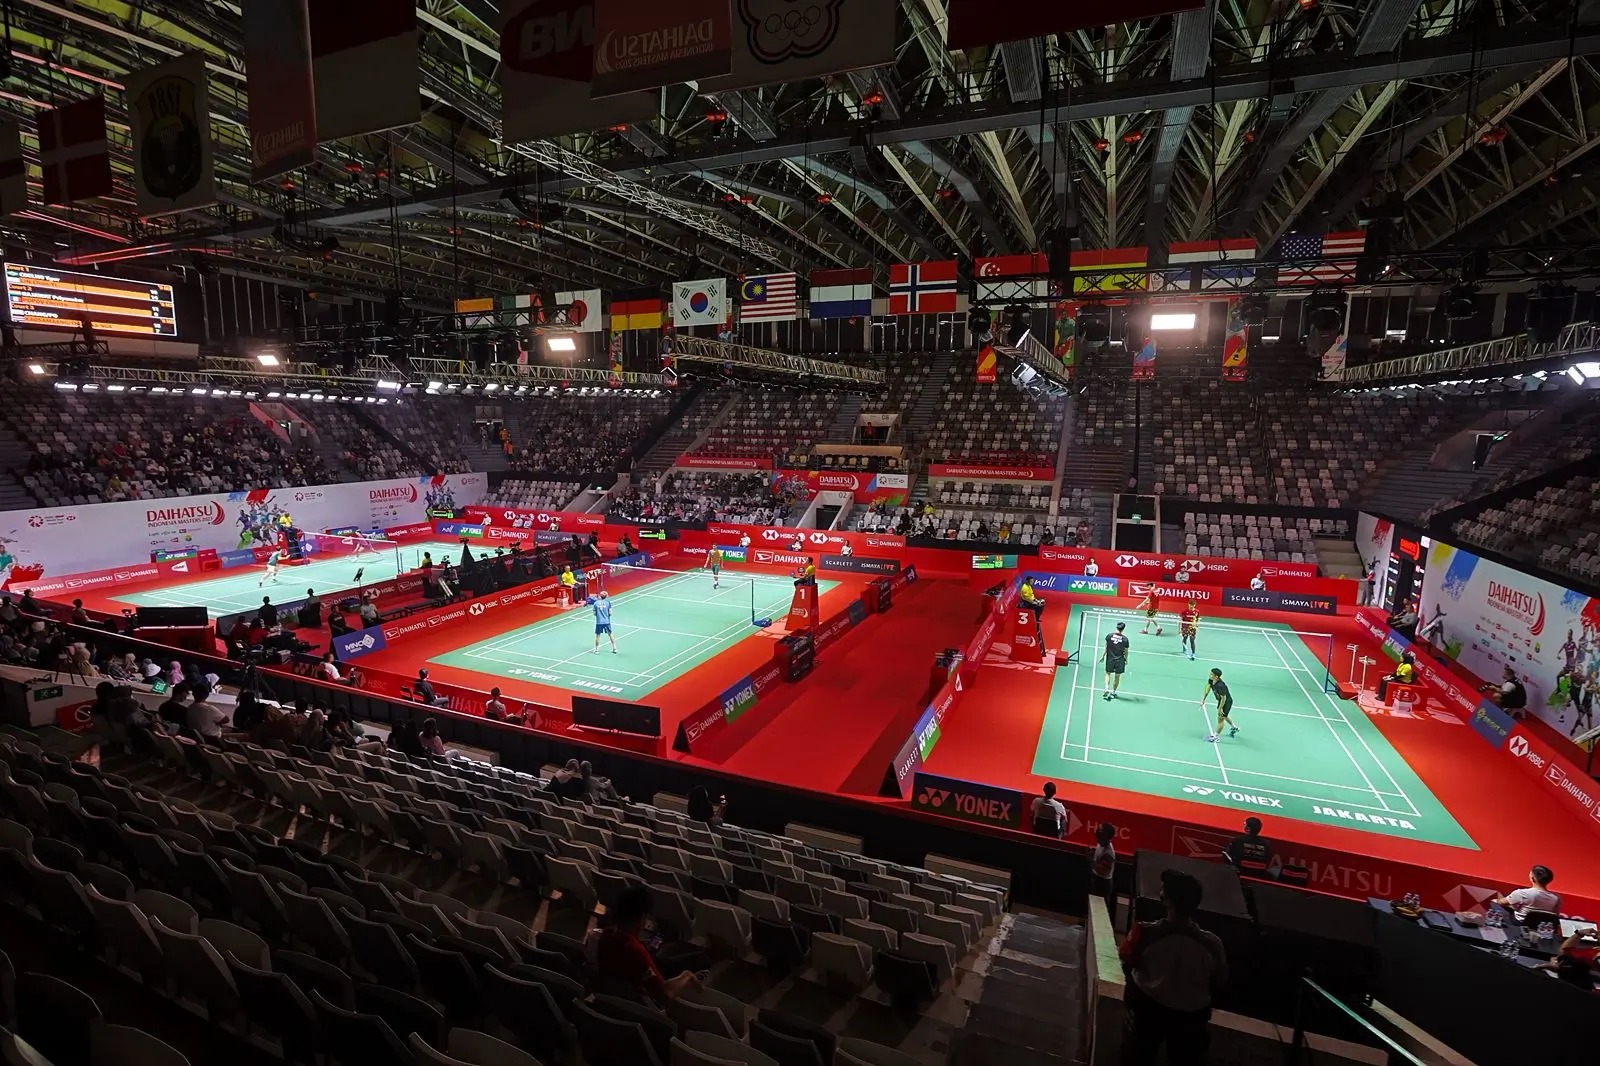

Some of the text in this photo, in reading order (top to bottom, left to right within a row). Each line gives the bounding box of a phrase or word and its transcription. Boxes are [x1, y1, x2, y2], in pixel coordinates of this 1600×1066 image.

[819, 475, 853, 484] DAIHATSU
[369, 487, 410, 500] DAIHATSU
[146, 505, 213, 522] DAIHATSU
[279, 534, 283, 542] 2
[502, 530, 530, 539] DAIHATSU
[725, 550, 745, 558] YONEX
[1057, 553, 1085, 561] DAIHATSU
[774, 555, 808, 565] DAIHATS
[1140, 559, 1161, 567] HSBC
[130, 568, 158, 578] DAIHATSU
[1207, 564, 1229, 572] HSBC
[1278, 569, 1312, 578] DAIHATSU
[83, 575, 113, 585] DAIHATSU
[31, 583, 64, 593] DAIHATSU
[1087, 581, 1114, 591] YONEX
[800, 588, 805, 599] 1
[1158, 587, 1210, 600] DAIHATSU
[1231, 595, 1270, 603] SCARLETT
[1487, 580, 1538, 616] DAIHATSU
[484, 600, 498, 609] HSBC
[441, 609, 465, 622] DAIHATSU
[1018, 612, 1029, 625] 3
[399, 621, 427, 634] DAIHATSU
[345, 641, 364, 651] MNC
[527, 671, 563, 682] YONEX
[734, 685, 755, 706] YONEX
[700, 709, 724, 731] DAIHATSU
[899, 746, 920, 780] SCARLETT
[1526, 751, 1545, 769] HSBC
[1560, 778, 1595, 808] DAIHATSU
[1219, 789, 1284, 809] YONEX
[954, 792, 1012, 821] YONEX
[1312, 805, 1417, 831] JAKARTA
[1086, 820, 1131, 840] HBC
